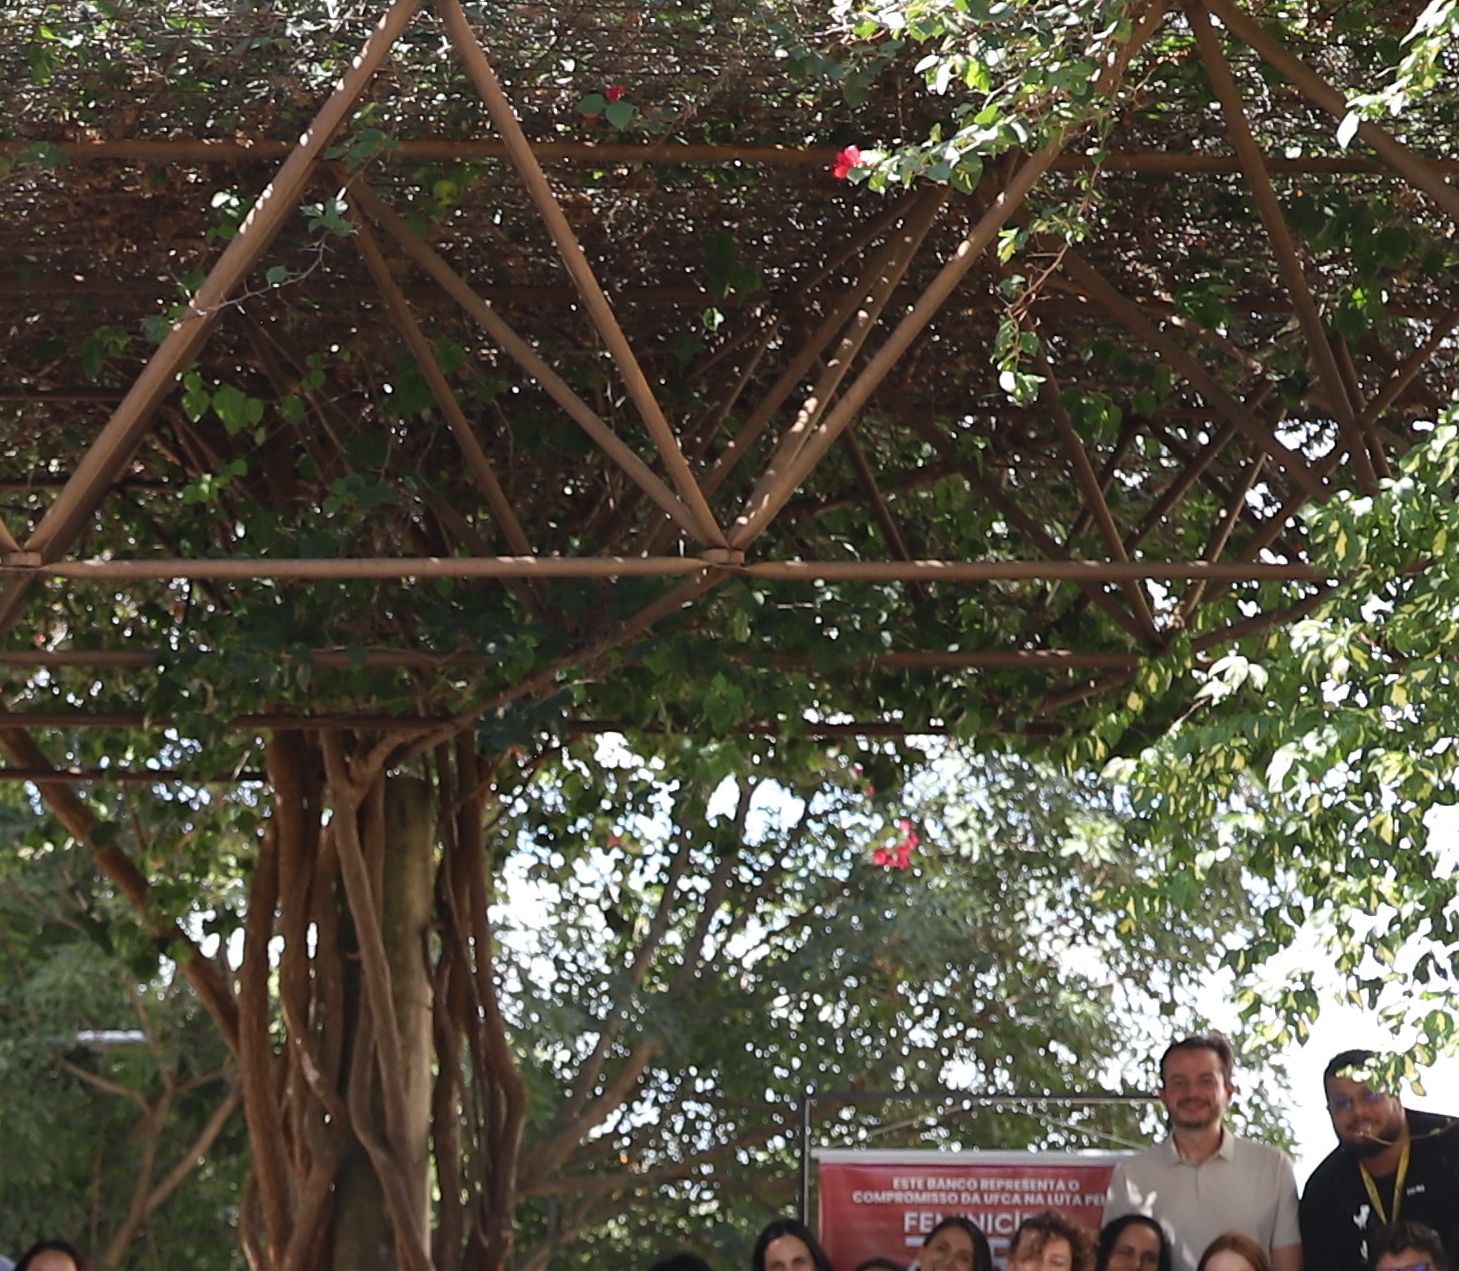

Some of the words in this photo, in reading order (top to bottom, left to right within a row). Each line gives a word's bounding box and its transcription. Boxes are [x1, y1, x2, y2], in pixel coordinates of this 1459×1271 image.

[893, 1177, 925, 1190] ESTE
[927, 1177, 977, 1191] BANCO
[980, 1178, 1065, 1192] REPRESENTA
[1068, 1180, 1080, 1192] O
[852, 1190, 958, 1204] COMPROMISSO
[960, 1191, 981, 1205] DA
[984, 1192, 1022, 1205] UFCA
[1024, 1193, 1045, 1205] NA
[1048, 1194, 1082, 1206] LUTA
